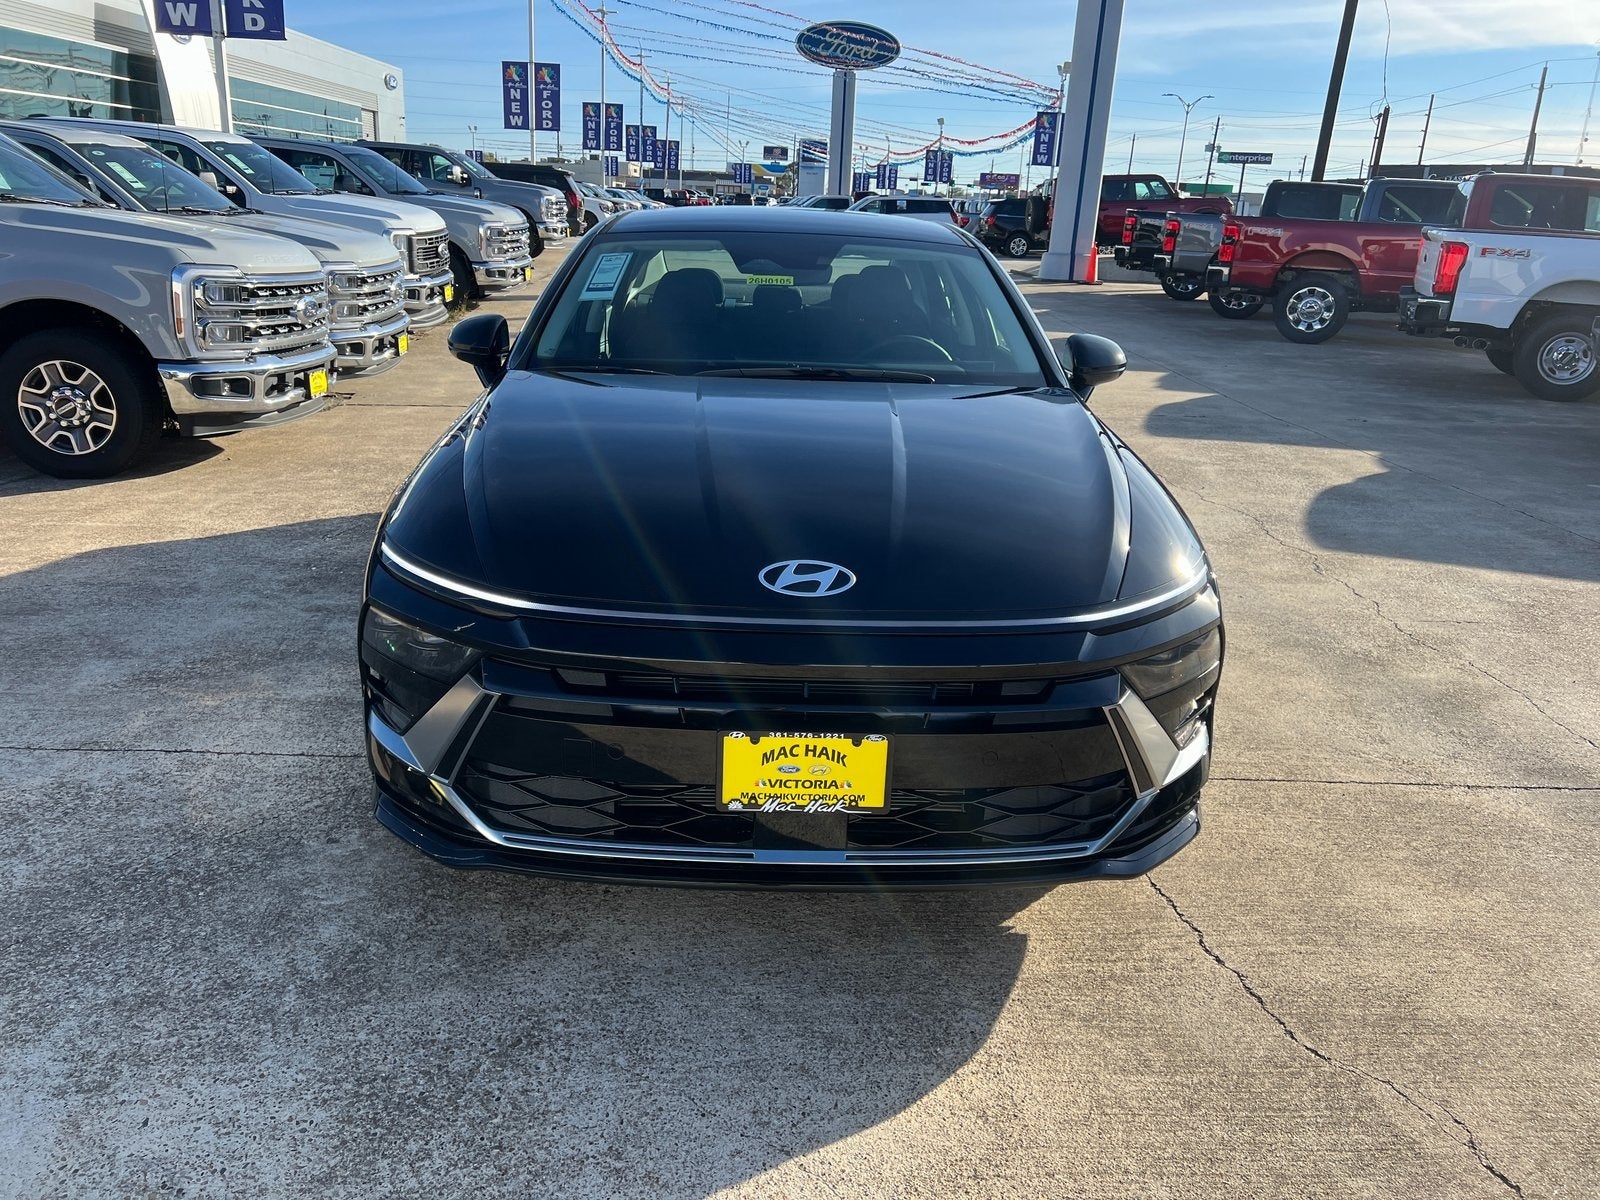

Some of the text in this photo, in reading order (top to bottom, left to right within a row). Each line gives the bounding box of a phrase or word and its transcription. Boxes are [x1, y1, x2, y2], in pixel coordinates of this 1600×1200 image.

[818, 31, 879, 60] Ford
[509, 88, 523, 126] NEW
[541, 90, 553, 128] FORD
[586, 121, 597, 148] NEW
[609, 123, 618, 150] FORD
[628, 139, 637, 160] NEW
[1036, 133, 1049, 164] NEW
[1221, 154, 1272, 162] enterprise
[926, 162, 934, 181] NEW
[1247, 226, 1284, 237] FX4
[1480, 247, 1531, 258] FX4
[748, 277, 792, 285] 26H0105
[769, 731, 845, 739] 361-576-1221
[761, 744, 848, 768] MAC HAIK
[767, 778, 839, 790] VICTORIA
[760, 798, 848, 813] Mac Haik
